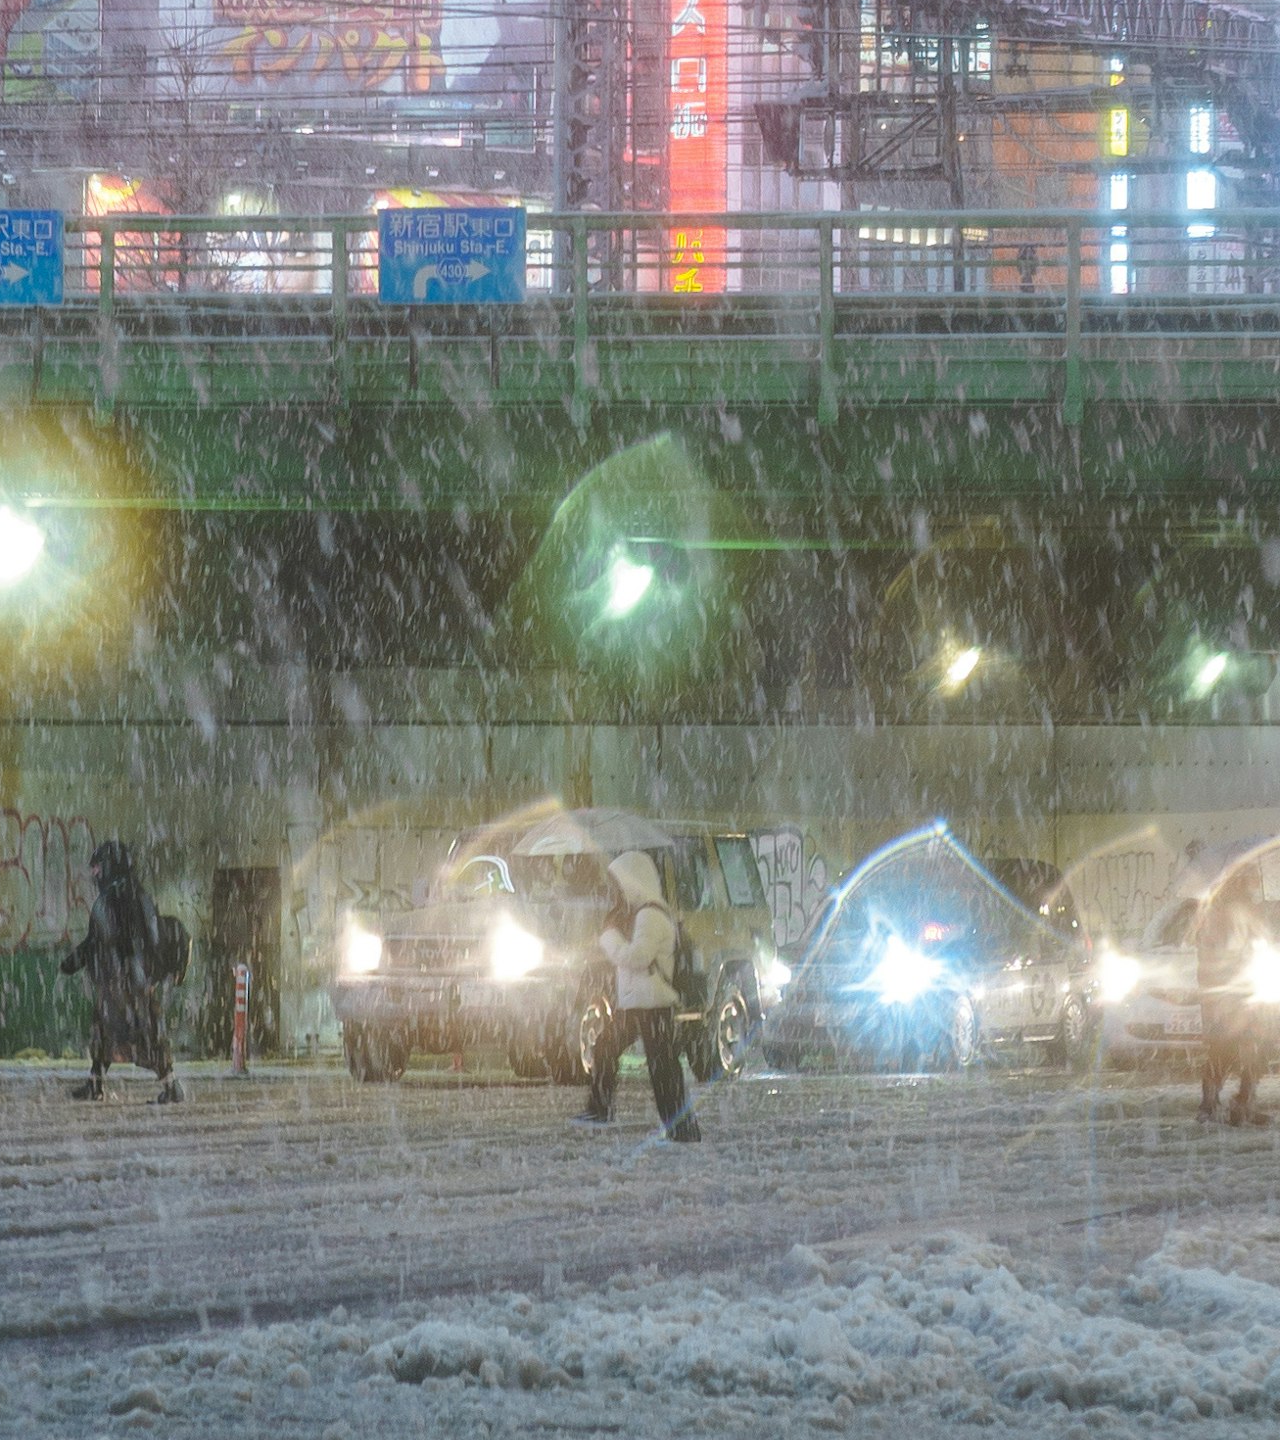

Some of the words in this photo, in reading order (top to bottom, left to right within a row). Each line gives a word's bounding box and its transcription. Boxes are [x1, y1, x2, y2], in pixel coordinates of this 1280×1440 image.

[389, 212, 513, 238] 新宿駅東口
[394, 239, 454, 257] Shinjuku
[440, 264, 464, 279] 430
